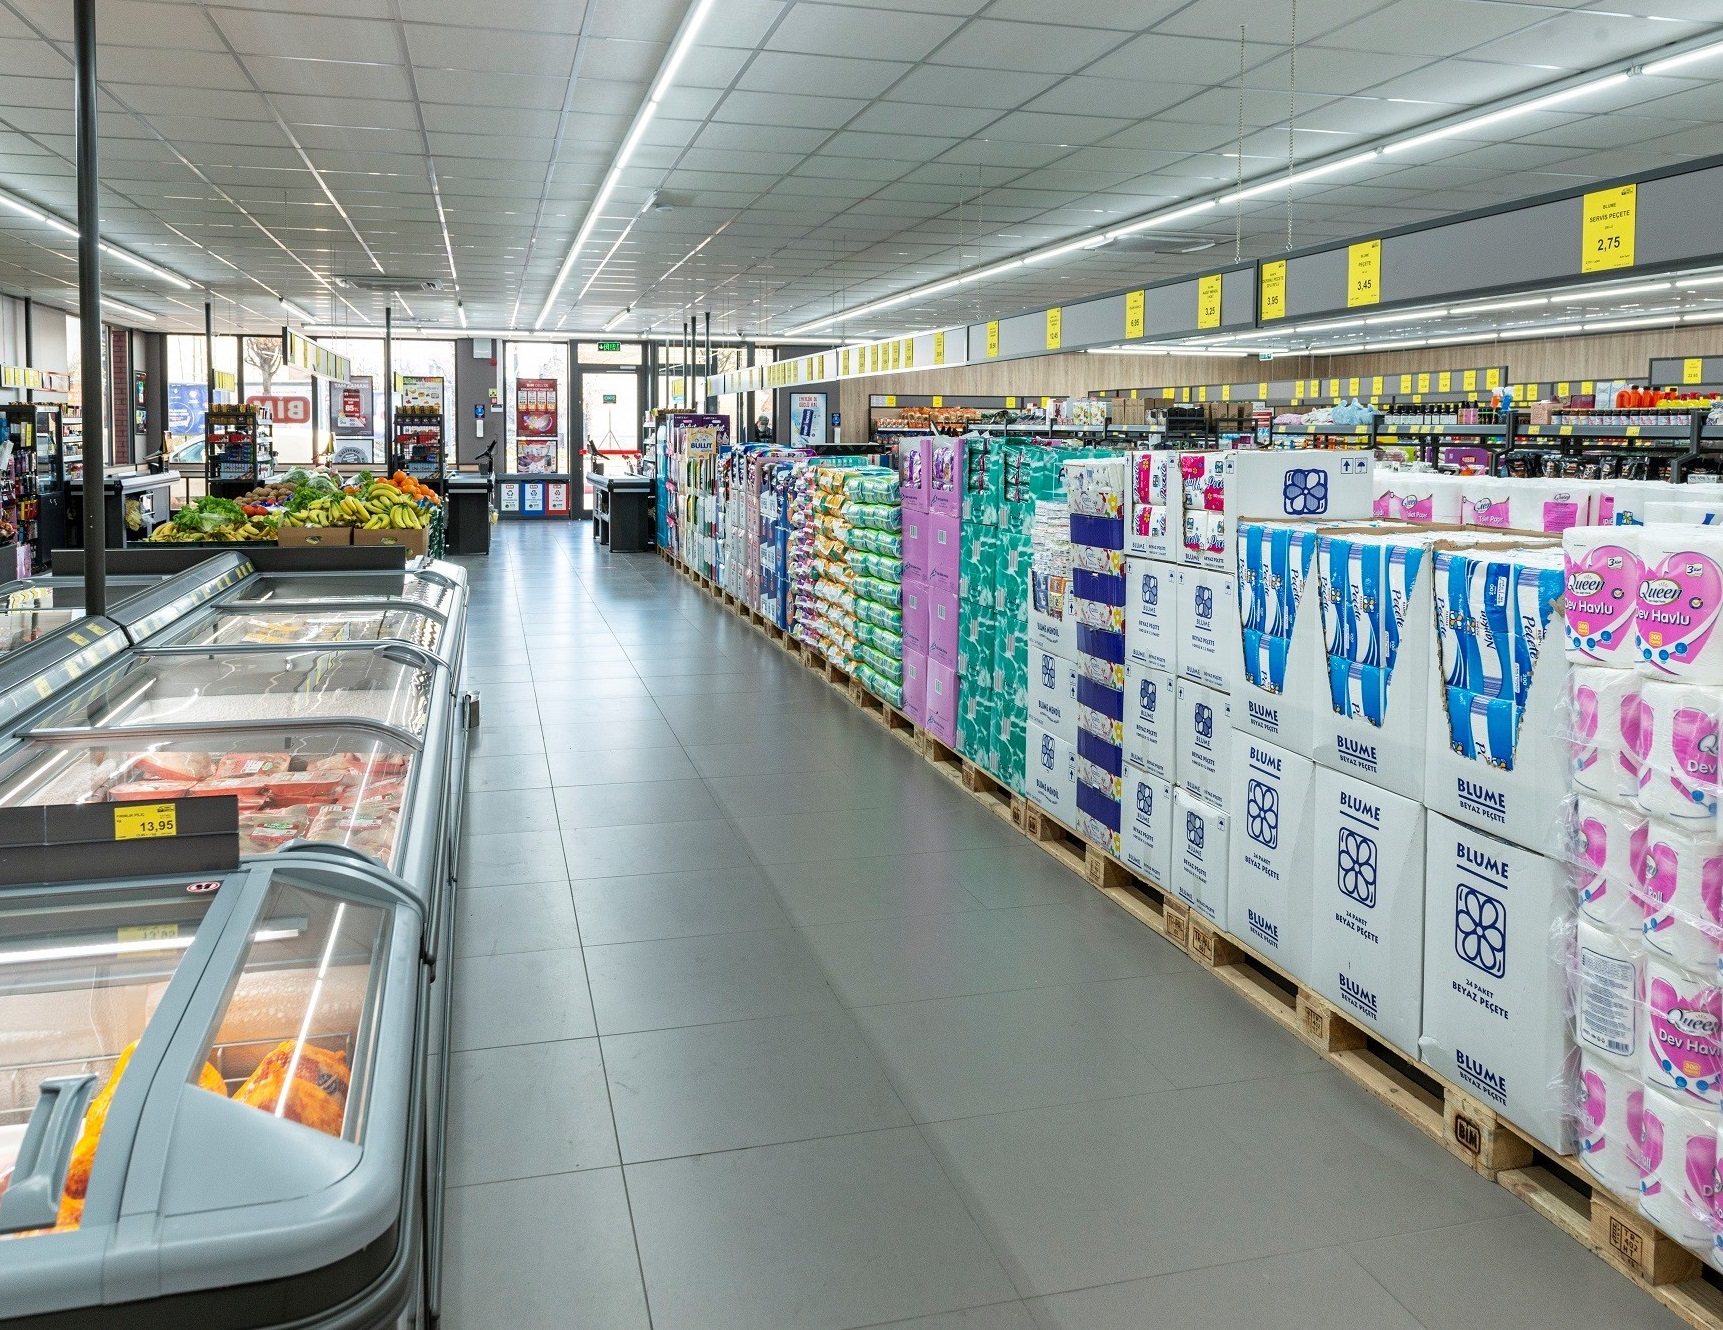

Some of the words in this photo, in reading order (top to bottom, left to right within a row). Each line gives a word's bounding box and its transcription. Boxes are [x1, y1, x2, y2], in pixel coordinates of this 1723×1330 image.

[1608, 209, 1630, 219] PEÇETE
[1597, 236, 1620, 252] 2,75
[1357, 279, 1372, 291] 3,45
[1267, 295, 1279, 306] 3,95
[1205, 306, 1215, 316] 3,25
[1567, 573, 1605, 592] Queen
[1638, 580, 1682, 600] Queen
[1143, 604, 1156, 614] BLUME
[1578, 600, 1613, 616] Havlu
[1651, 610, 1691, 626] Havlu
[1196, 618, 1210, 628] BLUME
[1522, 615, 1539, 660] Peçete
[1249, 700, 1278, 722] BLUME
[1250, 718, 1264, 729] BEYAZ
[1264, 723, 1278, 734] PEÇETE
[1196, 735, 1210, 747] BLUME
[1337, 734, 1377, 760] BLUME
[1250, 746, 1281, 772] BLUME
[1339, 754, 1357, 767] BEYAZ
[1358, 760, 1377, 773] PEÇETE
[1687, 759, 1717, 774] Dev
[1457, 777, 1505, 808] BLUME
[1340, 791, 1380, 821] BLUME
[1459, 801, 1481, 816] BEYAZ
[1482, 808, 1505, 823] PEÇETE
[140, 820, 174, 832] 13,95
[1245, 855, 1261, 868] BEYAZ
[1261, 865, 1279, 880] PEÇETE
[1457, 842, 1508, 879] BLUME
[1248, 908, 1278, 935] BLUME
[1336, 913, 1355, 930] BEYAZ
[1356, 924, 1378, 944] PEÇETE
[1352, 913, 1367, 927] PAKET
[1250, 926, 1263, 940] BEYAZ
[1263, 935, 1278, 949] PEÇETE
[1339, 972, 1377, 1008] BLUME
[1465, 979, 1473, 988] 24
[1474, 982, 1494, 998] PAKET
[1341, 993, 1358, 1008] BEYAZ
[1358, 1004, 1377, 1020] PEÇETE
[1452, 981, 1478, 1003] BEYAZ
[1479, 996, 1509, 1020] PEÇETE
[1659, 1028, 1683, 1049] Dev
[1687, 1039, 1721, 1057] Havl
[1456, 1048, 1506, 1093] BLUME
[1460, 1071, 1481, 1091] BEYAZ
[1482, 1086, 1506, 1107] PEÇETE
[1623, 1244, 1634, 1257] HT
